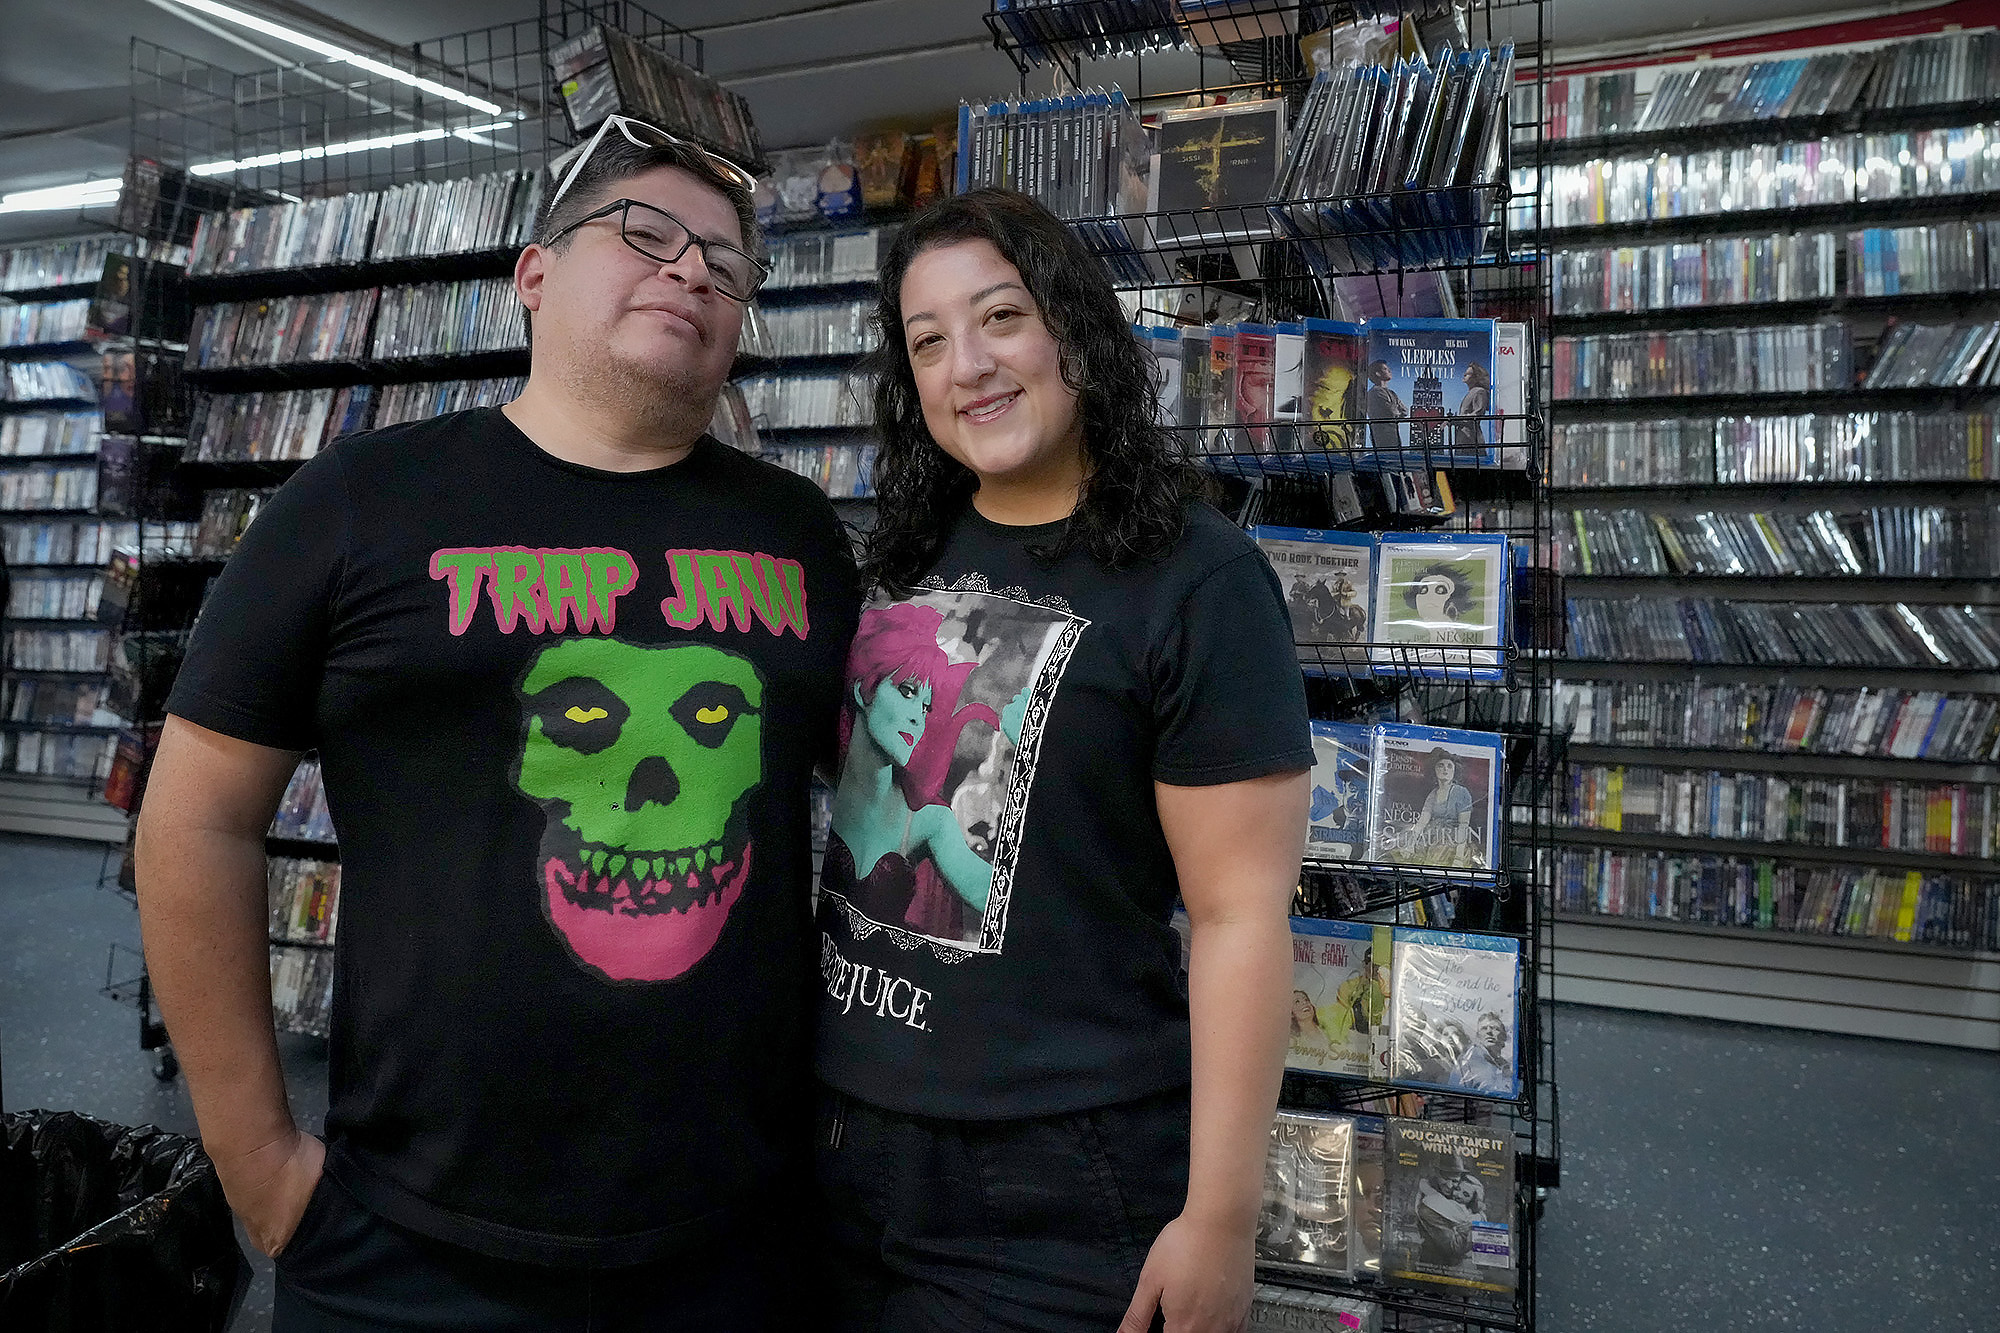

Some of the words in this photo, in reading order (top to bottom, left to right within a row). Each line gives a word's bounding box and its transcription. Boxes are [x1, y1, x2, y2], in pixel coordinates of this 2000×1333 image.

[1445, 81, 1460, 121] PHILADELPHIA
[1400, 338, 1416, 347] HANKS
[1456, 339, 1468, 348] RYAN
[1401, 349, 1456, 366] SLEEPLESS
[1401, 367, 1411, 378] IN
[1414, 367, 1455, 380] SEATTLE
[1314, 554, 1360, 568] TOGETHER
[429, 545, 640, 637] TRAP
[661, 548, 810, 641] JAW
[1384, 808, 1421, 823] NEGR
[1325, 942, 1347, 953] CARY
[1321, 952, 1349, 968] GRANT
[1456, 976, 1481, 991] and
[1399, 1127, 1424, 1141] YOU
[1424, 1131, 1460, 1145] CAN'T
[1461, 1135, 1490, 1150] TAKE
[1492, 1139, 1504, 1151] IT
[1422, 1141, 1453, 1155] WITH
[1453, 1144, 1480, 1159] YOU
